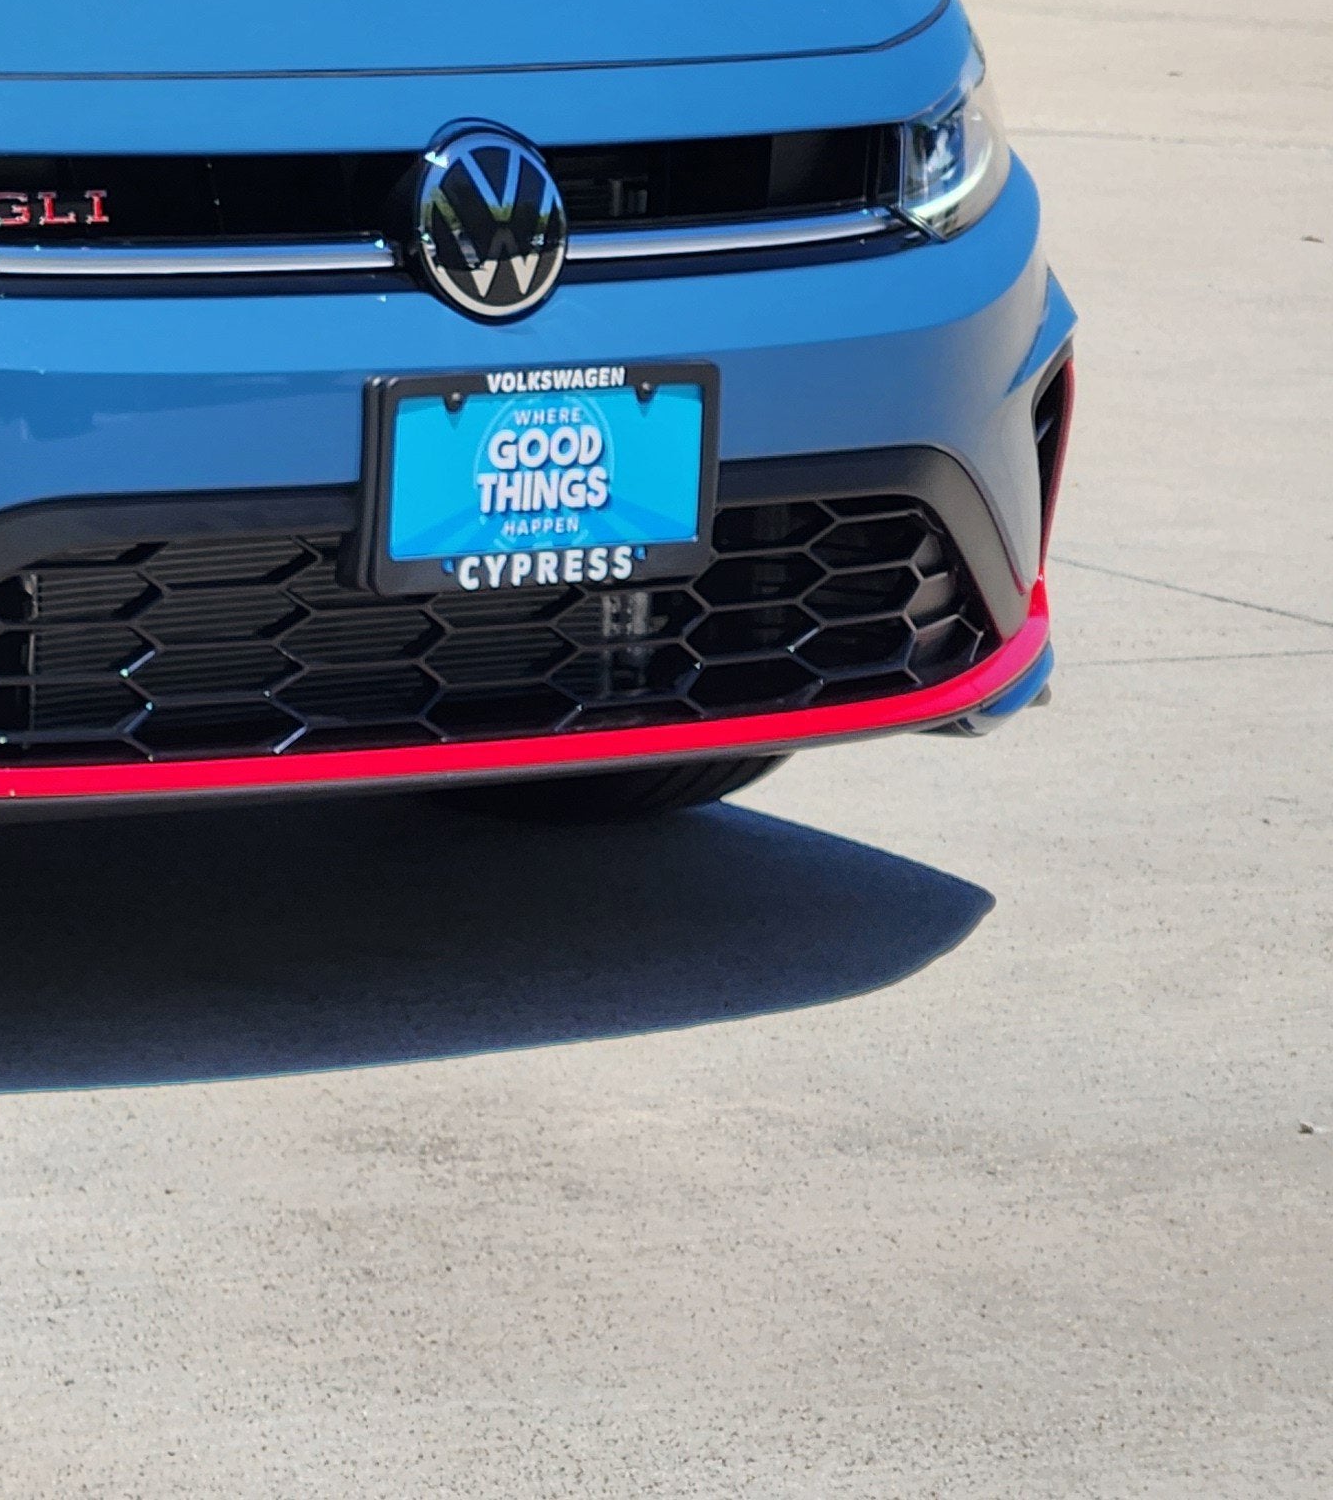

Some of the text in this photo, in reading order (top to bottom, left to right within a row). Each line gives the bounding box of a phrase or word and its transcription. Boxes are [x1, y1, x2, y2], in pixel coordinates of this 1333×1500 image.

[487, 367, 625, 393] VOLKSWAGEN
[514, 407, 582, 425] WHERE
[488, 425, 603, 469] GOOD
[477, 466, 608, 513] THINGS
[502, 517, 579, 536] HAPPEN
[458, 546, 633, 590] CYPRESS
